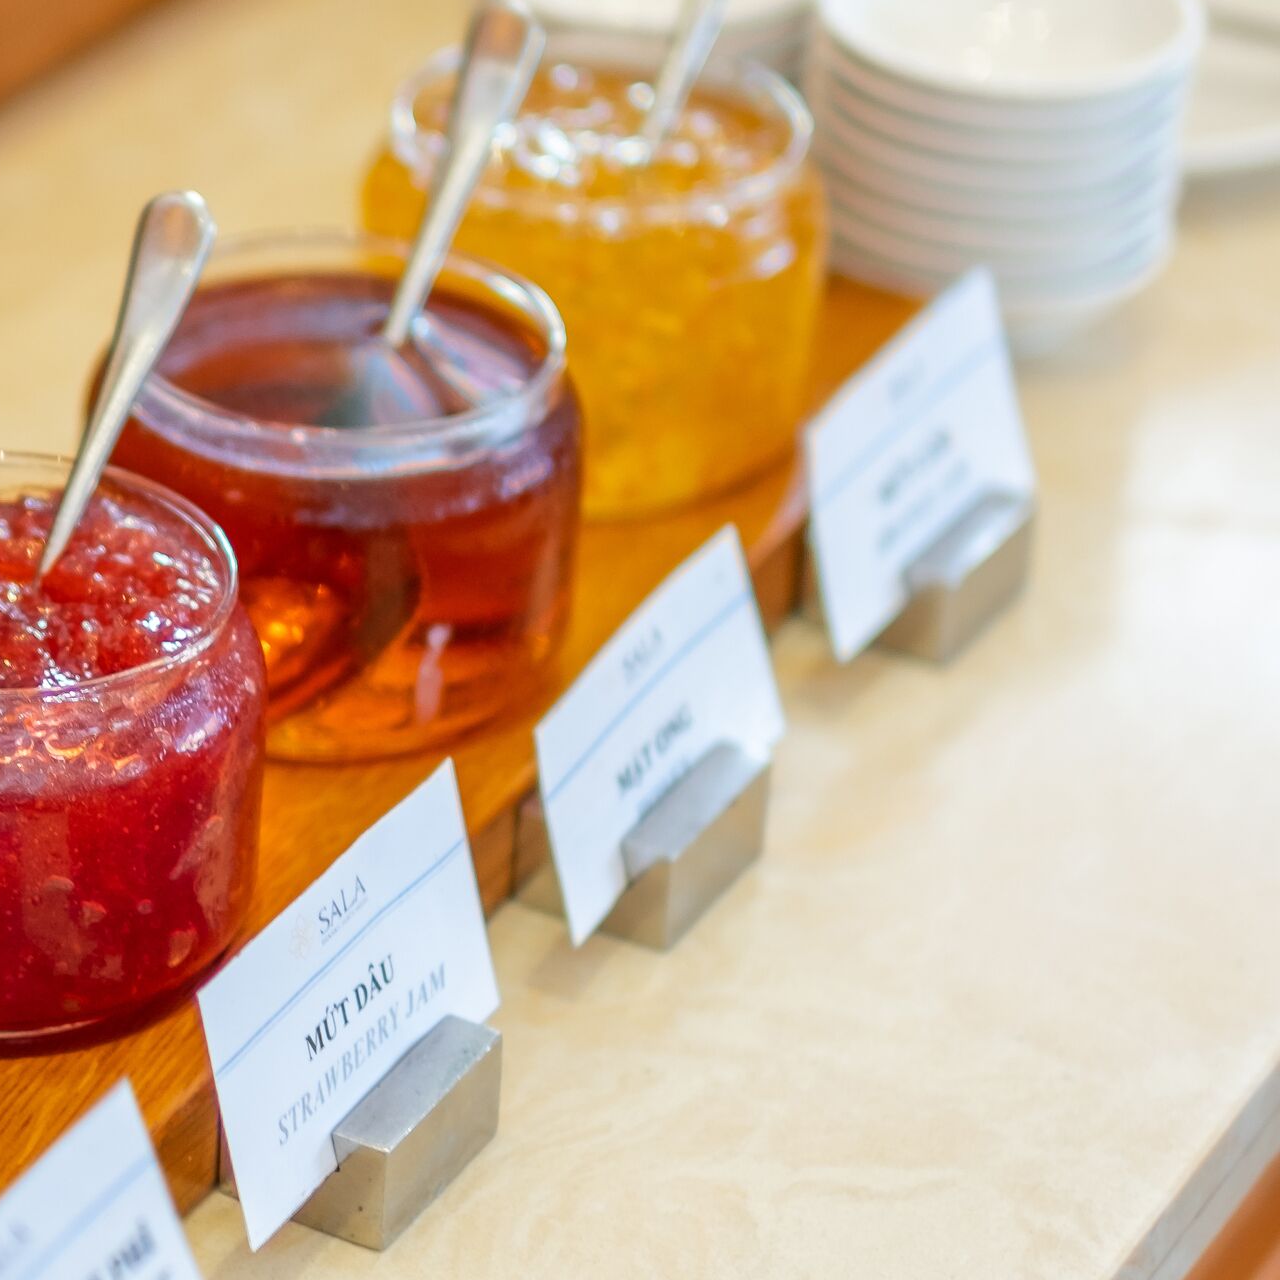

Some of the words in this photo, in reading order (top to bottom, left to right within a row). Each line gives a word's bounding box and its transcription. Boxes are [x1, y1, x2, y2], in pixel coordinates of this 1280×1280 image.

[318, 873, 367, 935] SALA
[277, 1001, 402, 1146] STRAWBERRY
[404, 962, 447, 1019] JAM
[304, 996, 350, 1062] MỨT
[352, 953, 396, 1013] DÂU
